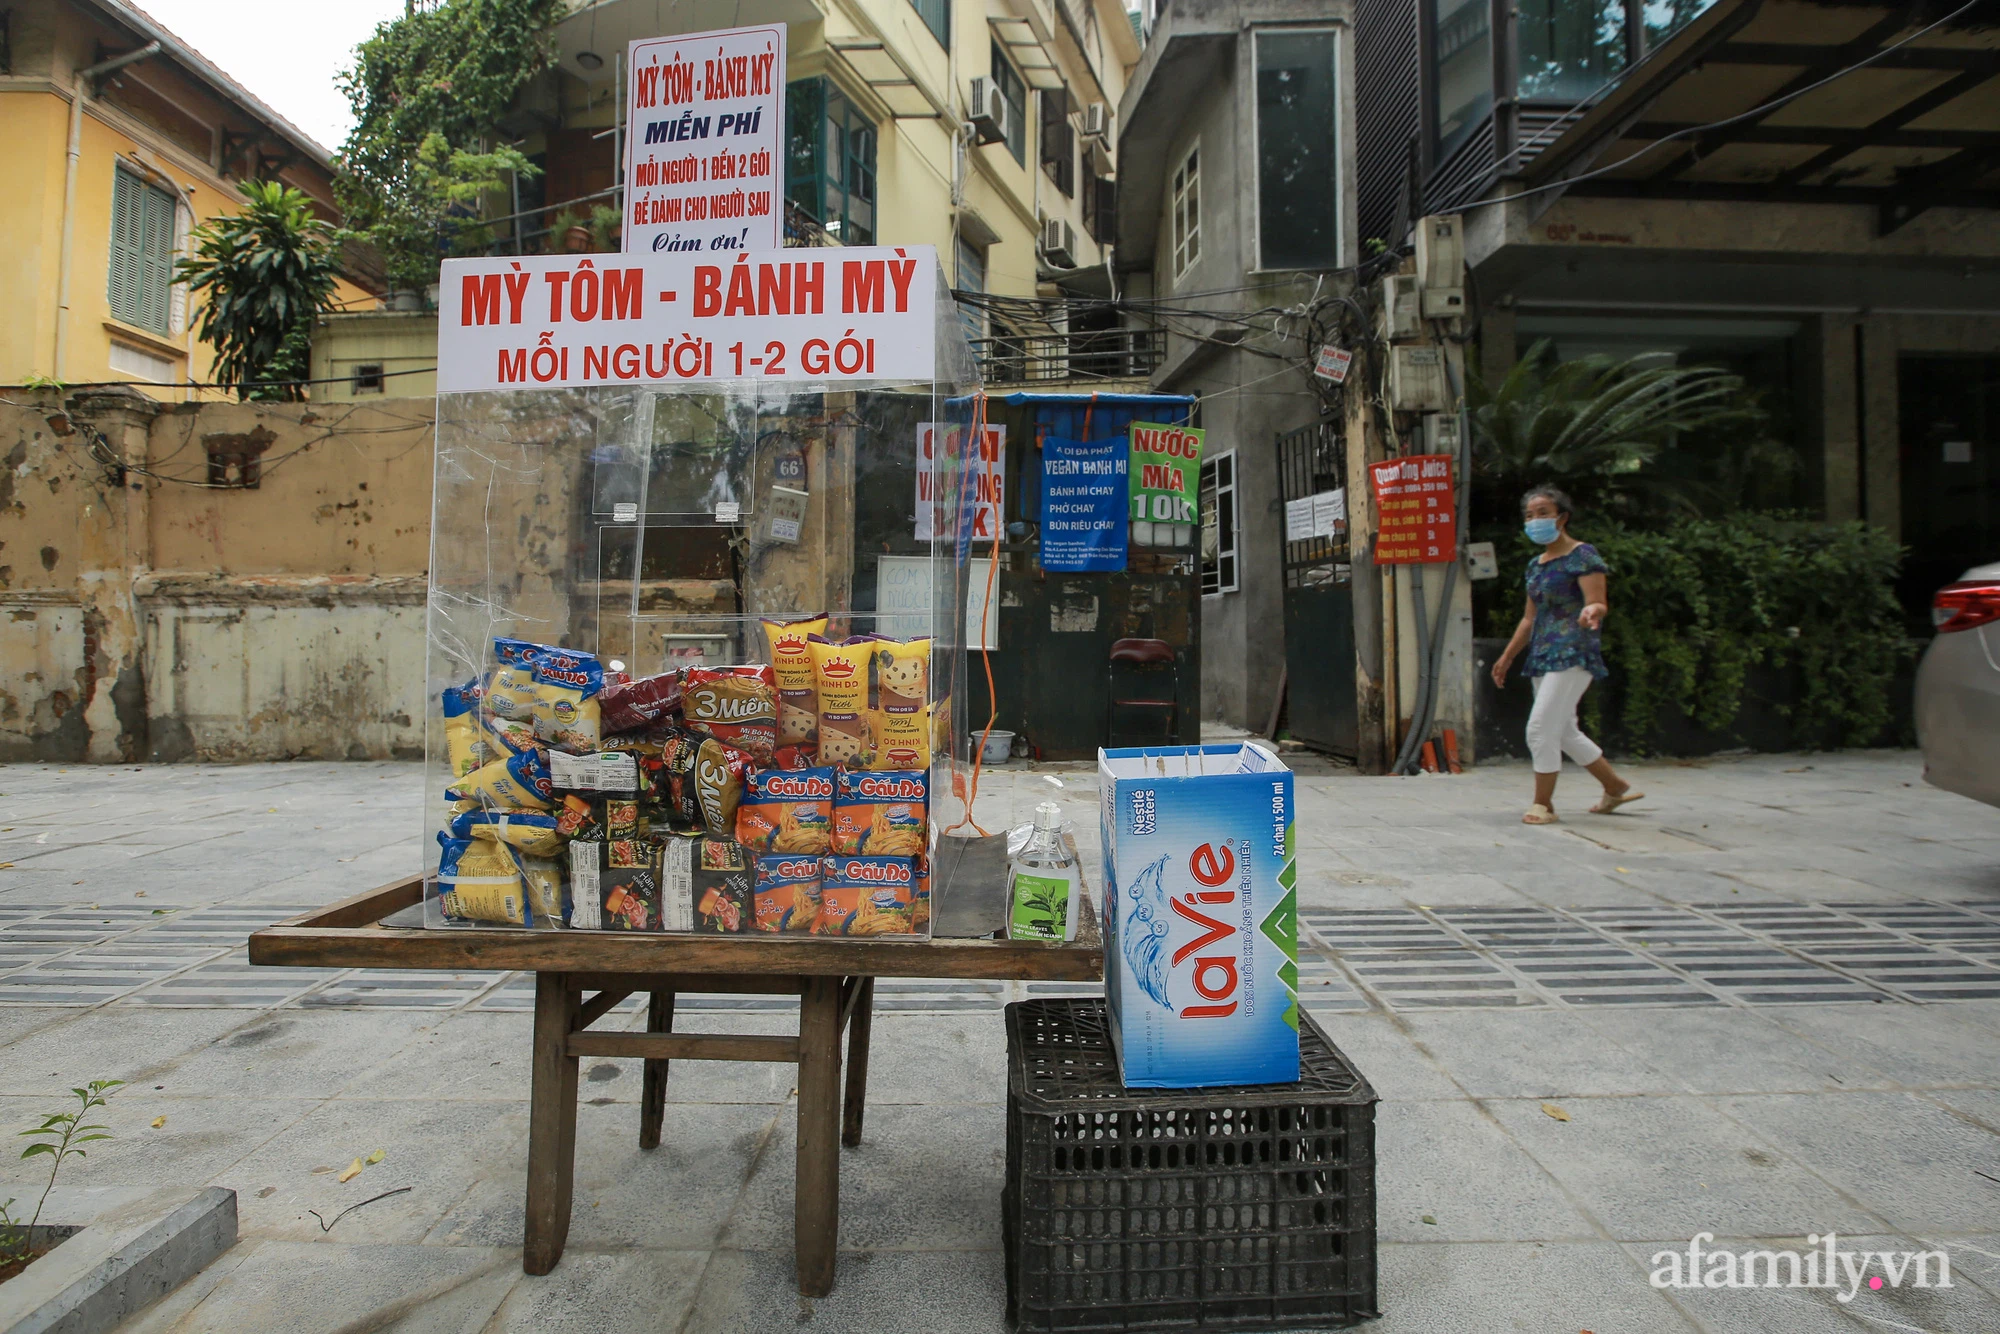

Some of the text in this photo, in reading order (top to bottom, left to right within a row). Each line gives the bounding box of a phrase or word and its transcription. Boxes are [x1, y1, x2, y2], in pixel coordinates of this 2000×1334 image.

[637, 54, 659, 108] MỲ
[662, 51, 694, 106] TÔM
[704, 46, 748, 100] BÁNH
[750, 41, 774, 96] MỲ
[645, 106, 763, 144] MIỄN PHÍ
[636, 147, 770, 187] MỖI NGƯỜI 1 ĐẾN 2 GÓI
[634, 188, 770, 225] ĐỂ DÀNH CHO NGƯỜI SAU
[652, 228, 748, 252] Cảm ơn!
[462, 248, 917, 326] MỲ TÔM - BÁNH MỲ
[498, 328, 874, 383] MỖI NGƯỜI 1-2 GÓI
[1134, 427, 1199, 459] NƯỚC
[1045, 460, 1126, 475] VEGAN BANH MI
[1142, 462, 1185, 492] MÍA
[1422, 459, 1447, 478] Juice
[1050, 485, 1114, 496] BÁNH MÌ CHAY
[1050, 502, 1094, 513] PHỞ CHAY
[1050, 520, 1115, 530] BÚN RIÊU CHAY
[695, 690, 716, 717] 3
[716, 697, 770, 719] Miền
[700, 759, 727, 786] 3
[767, 776, 833, 796] Gấu Đỏ
[859, 777, 925, 798] Gấu Đỏ
[1272, 782, 1284, 794] ml
[1132, 790, 1145, 836] Nestlé
[1144, 789, 1156, 834] Waters
[1272, 796, 1284, 814] 500
[1273, 822, 1284, 842] chai
[1273, 843, 1284, 856] 24
[777, 859, 817, 878] Gấu
[845, 860, 886, 880] Gấu
[886, 864, 911, 882] Đỏ
[639, 871, 656, 890] Hầm
[733, 873, 749, 891] Hầm
[1238, 840, 1254, 1017] 100% NƯỚC KHOÁNG THIÊN NHIÊN
